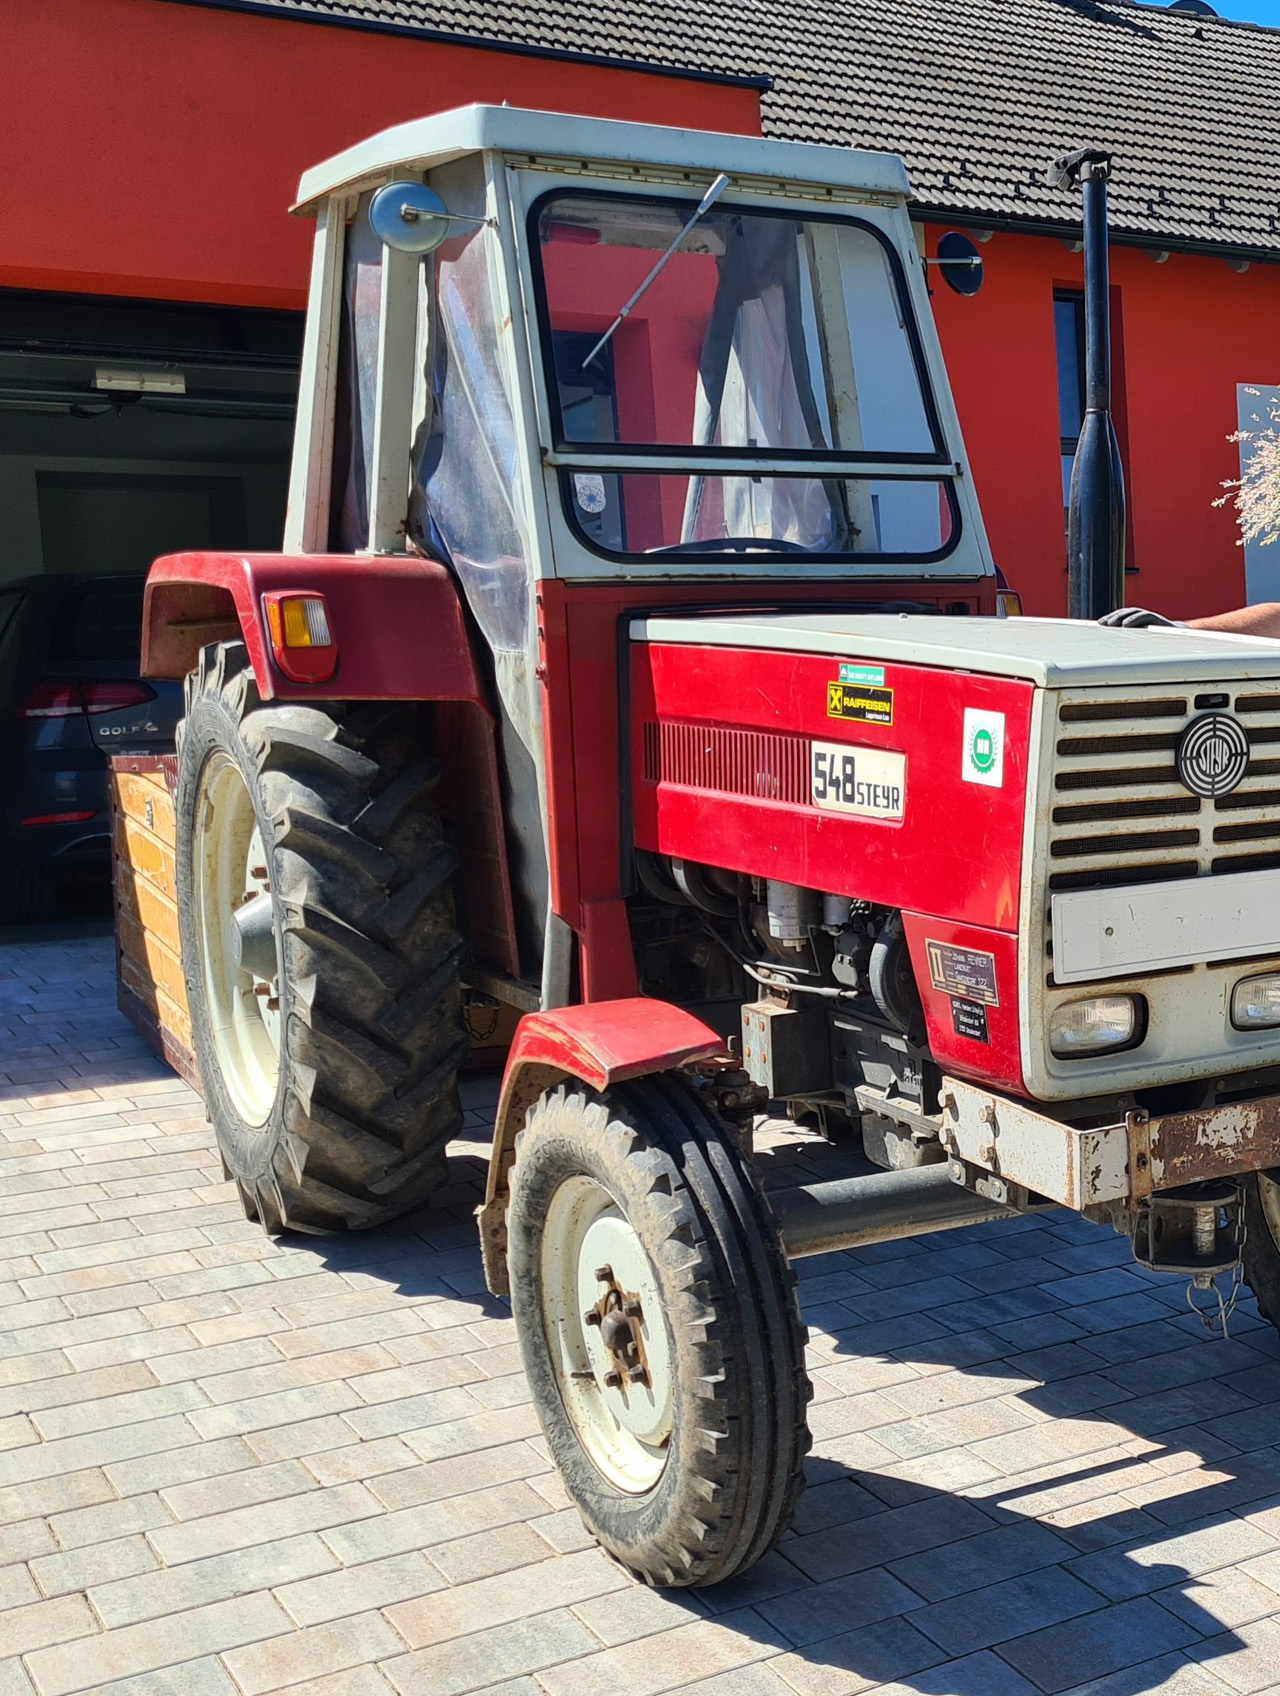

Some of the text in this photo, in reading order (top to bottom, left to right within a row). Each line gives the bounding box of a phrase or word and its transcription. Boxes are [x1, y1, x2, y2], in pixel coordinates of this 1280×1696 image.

[844, 697, 890, 712] RAIFFEISEN
[100, 727, 139, 735] GOLF
[1199, 738, 1230, 775] STEYR
[814, 751, 900, 811] 548 STEYR
